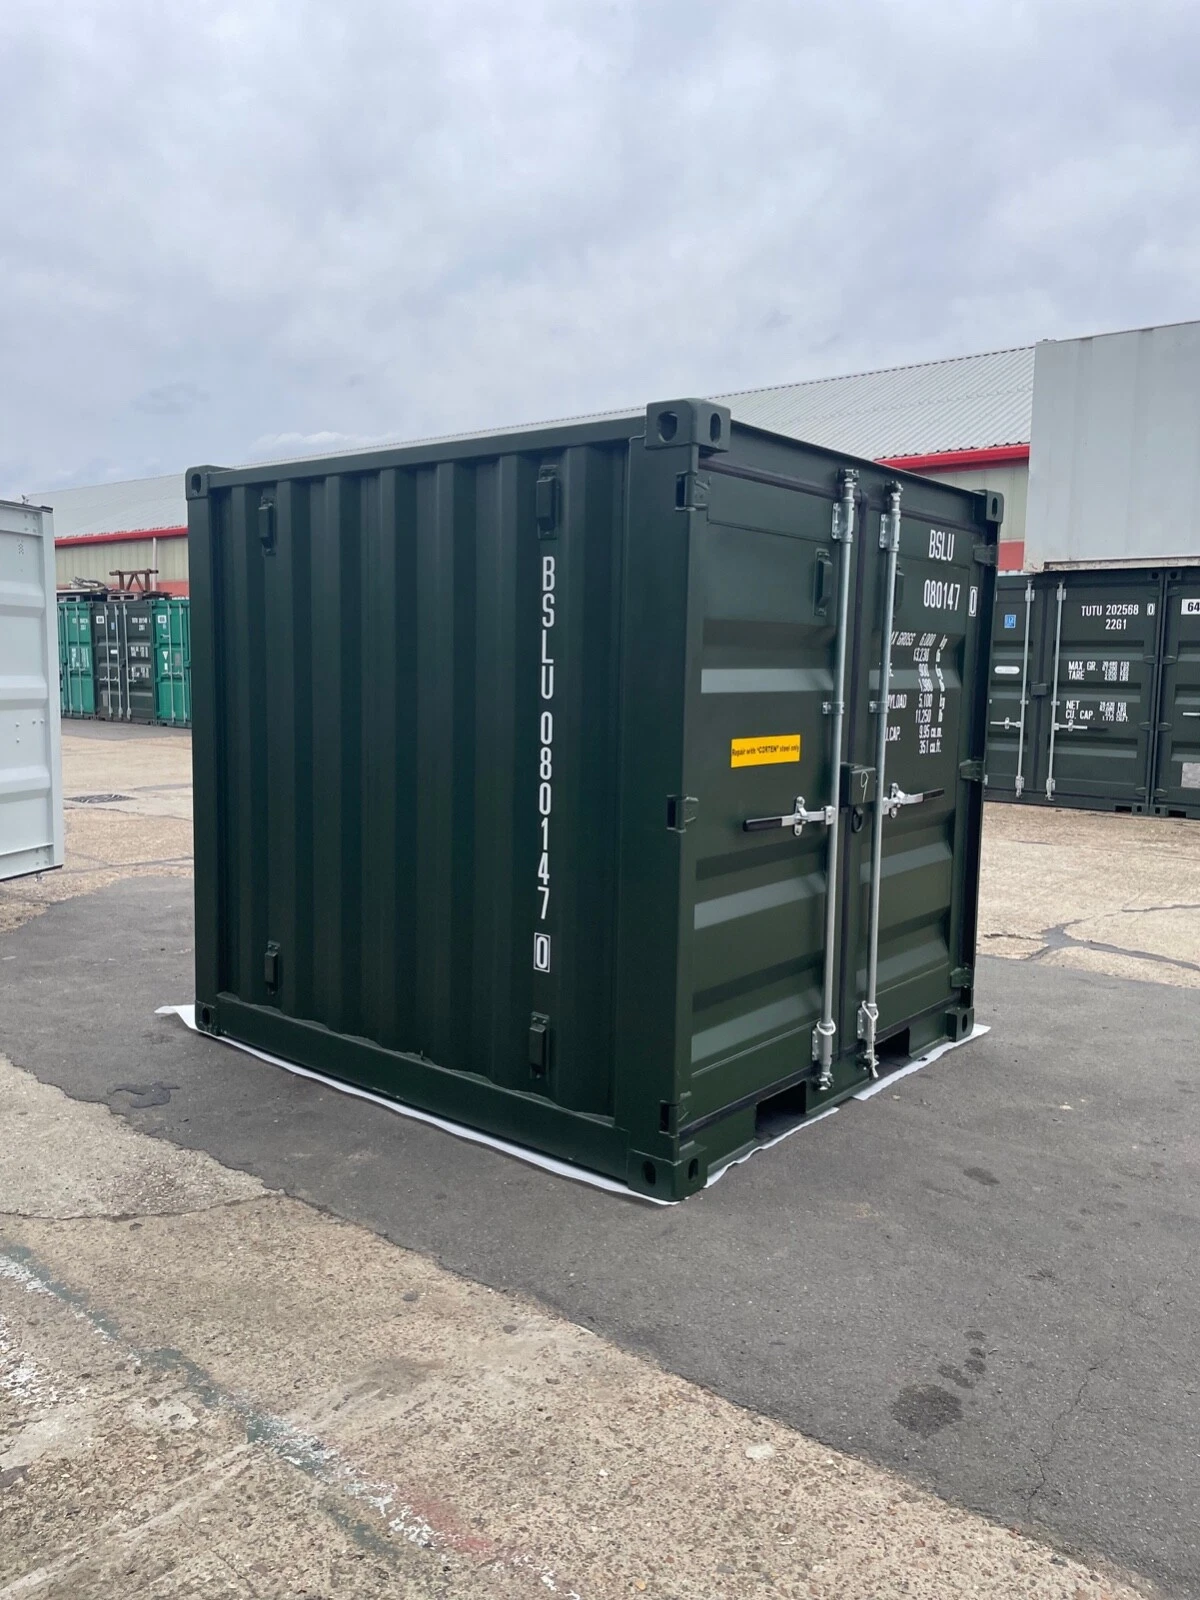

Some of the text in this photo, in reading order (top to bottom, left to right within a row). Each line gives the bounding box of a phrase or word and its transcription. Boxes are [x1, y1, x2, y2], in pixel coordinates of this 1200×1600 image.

[928, 529, 955, 561] BSLU
[923, 579, 977, 616] 080147 0
[1081, 605, 1102, 616] TUTU
[1105, 604, 1139, 616] 202568
[541, 556, 555, 700] BSLU
[1105, 618, 1127, 630] 22G1
[1068, 670, 1085, 680] TARE
[1066, 700, 1080, 710] NET
[1079, 710, 1096, 720] CAP.
[537, 711, 553, 920] 080147
